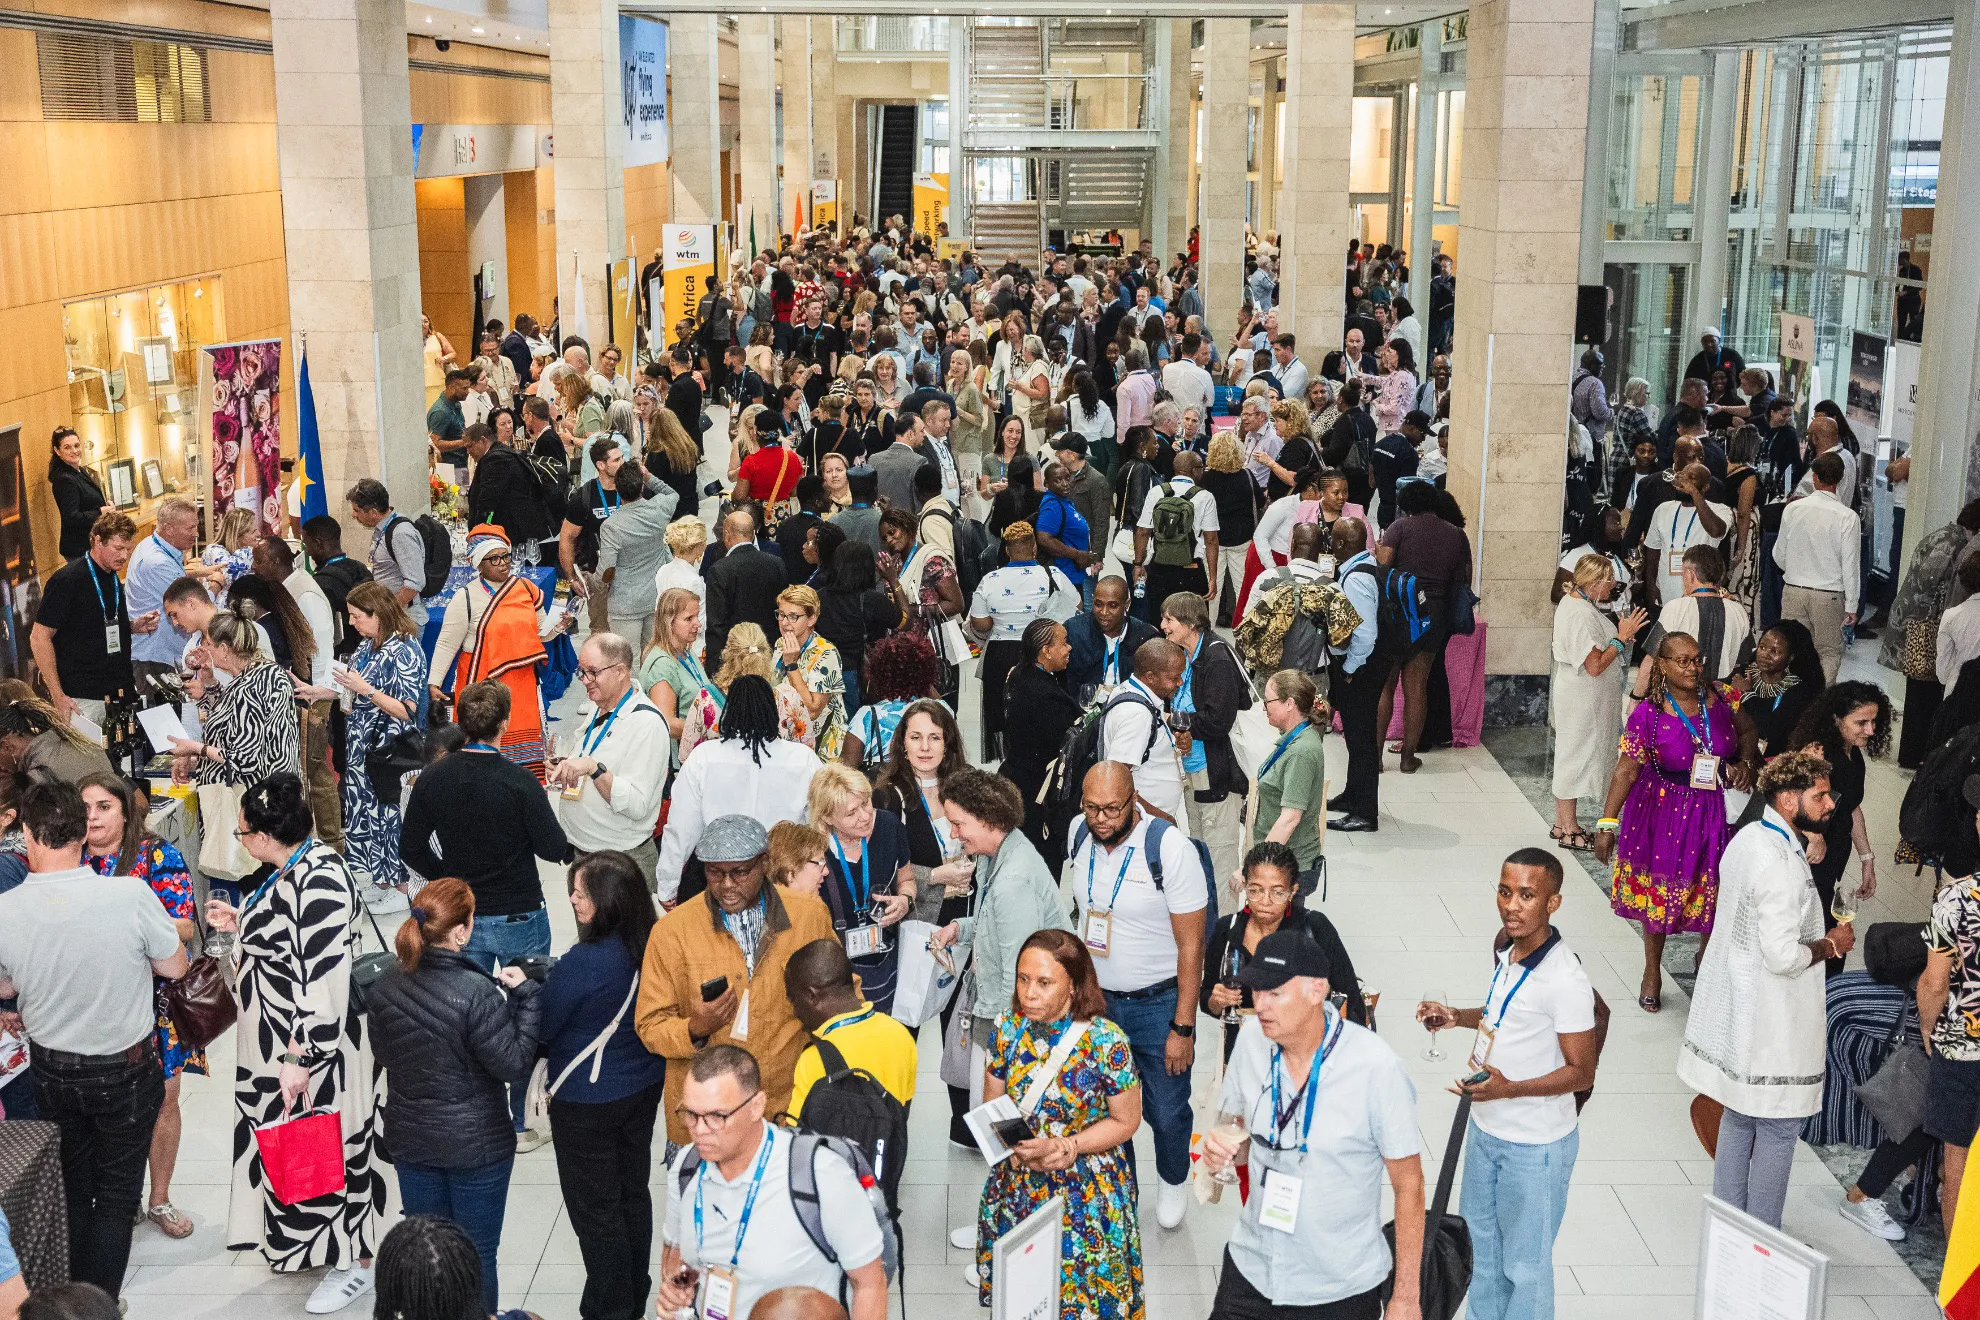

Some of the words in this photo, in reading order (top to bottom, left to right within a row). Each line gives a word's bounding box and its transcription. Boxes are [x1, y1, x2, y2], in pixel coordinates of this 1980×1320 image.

[639, 66, 652, 97] flying
[640, 102, 664, 124] experience
[676, 250, 700, 259] wtm
[683, 275, 695, 320] Africa
